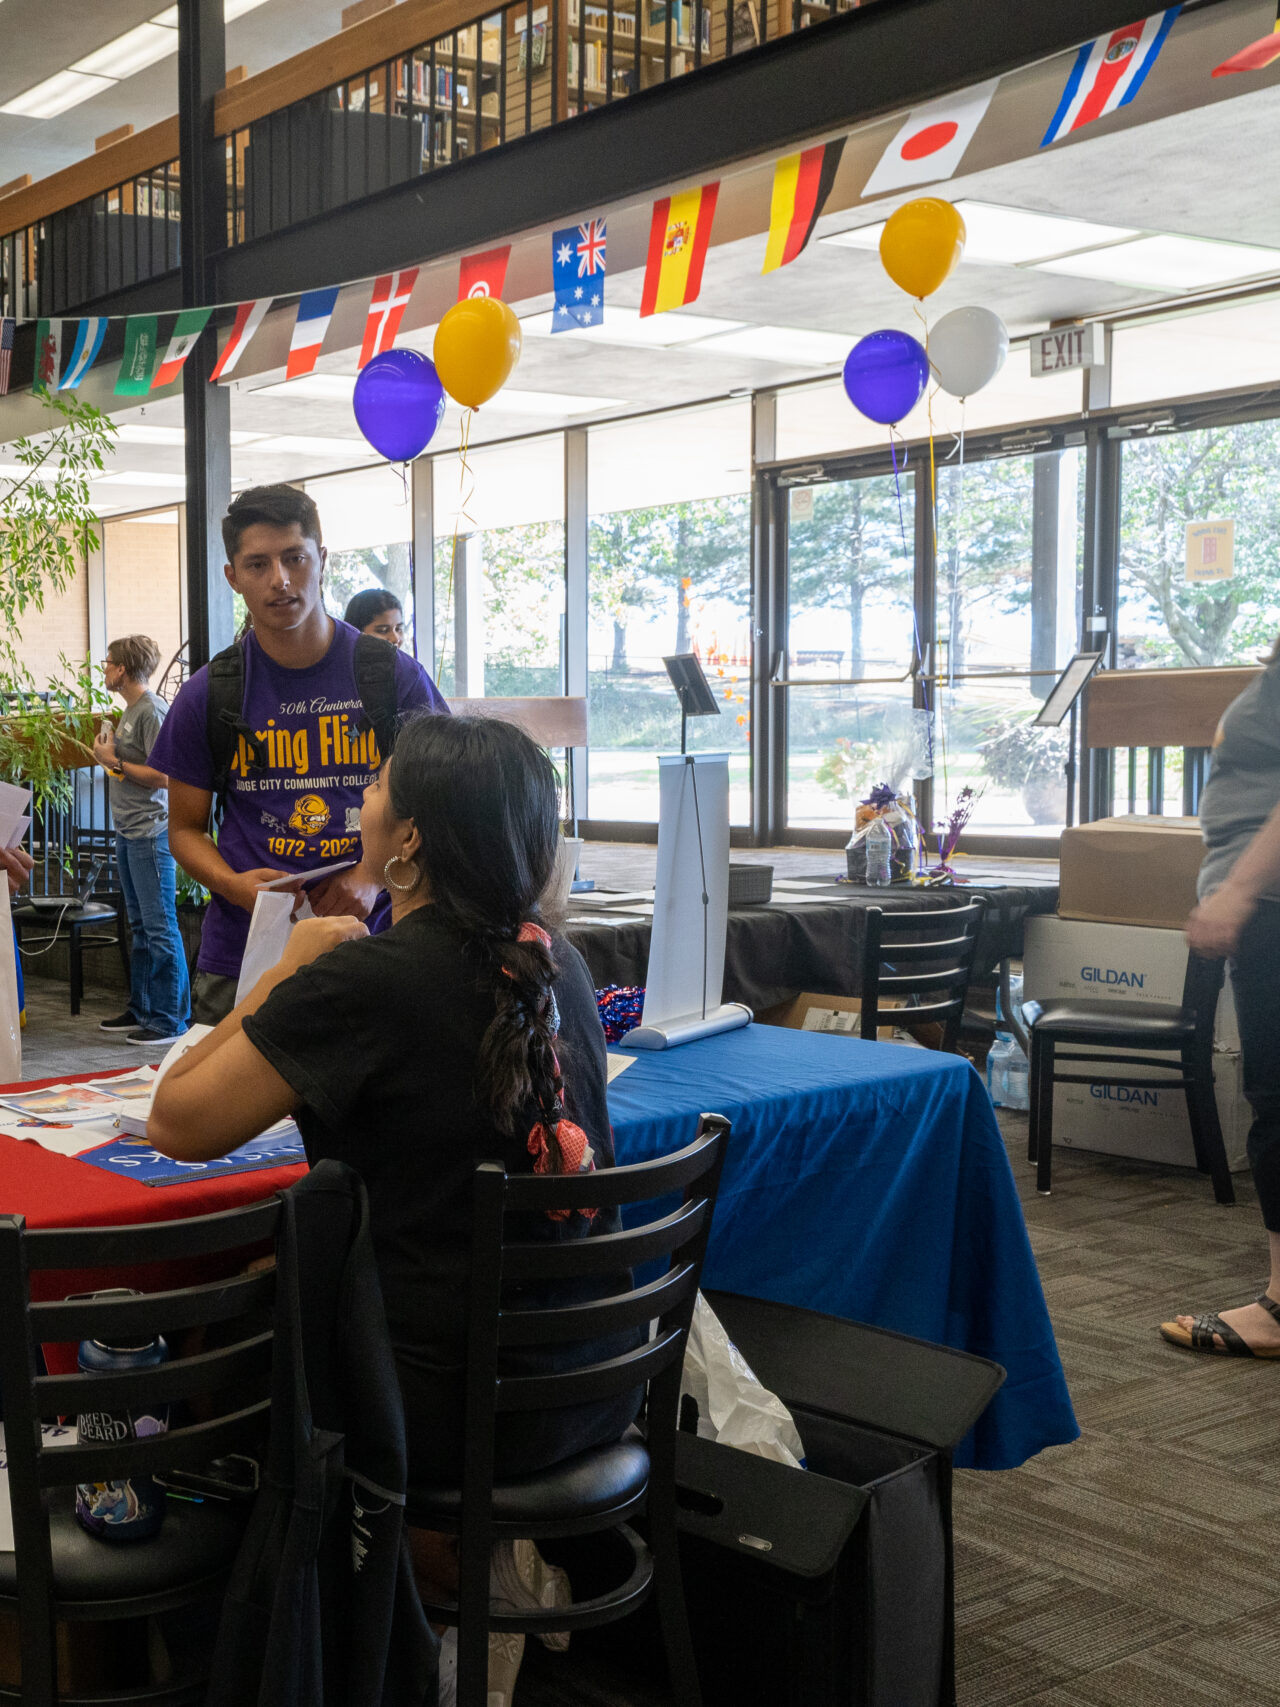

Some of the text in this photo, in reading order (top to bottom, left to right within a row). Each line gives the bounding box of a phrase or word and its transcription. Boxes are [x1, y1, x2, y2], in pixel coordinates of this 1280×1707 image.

[1040, 329, 1085, 371] EXIT
[279, 701, 307, 715] 50th
[260, 778, 281, 791] CITY
[284, 776, 340, 790] COMMUNITY
[267, 837, 305, 857] 1972
[1081, 966, 1145, 988] GILDAN
[1090, 1083, 1158, 1106] GILDAN
